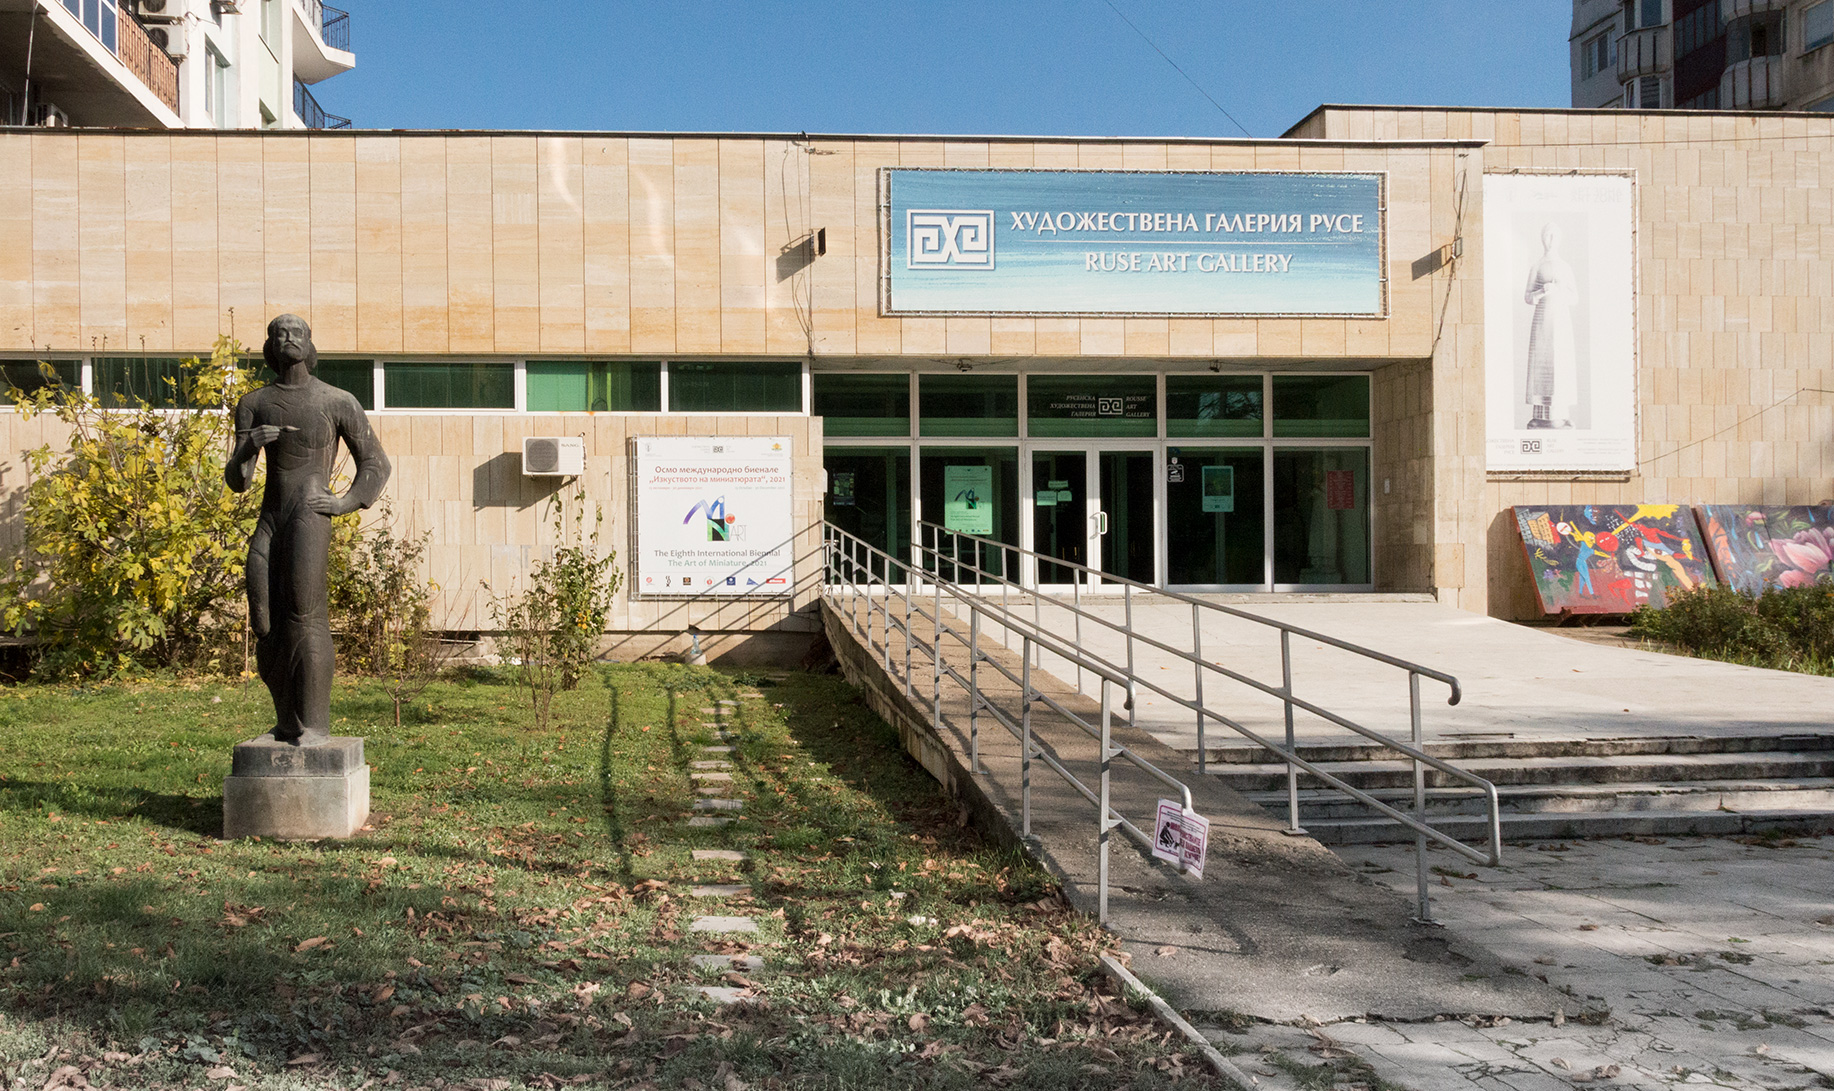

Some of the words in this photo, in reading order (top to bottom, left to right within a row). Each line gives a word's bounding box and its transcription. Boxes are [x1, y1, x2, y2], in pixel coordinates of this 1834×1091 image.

[1010, 211, 1199, 236] ХУДОЖЕСТВЕНА
[1205, 213, 1302, 233] ГАЛЕРИЯ
[1310, 214, 1364, 233] РУСЕ
[1085, 253, 1141, 272] RUSE
[1148, 253, 1190, 272] ART
[1197, 253, 1293, 273] GALLERY
[655, 466, 678, 474] Осмо
[679, 466, 742, 475] международно
[744, 466, 779, 474] биенале
[654, 549, 670, 557] The
[671, 549, 696, 559] Eighth
[697, 549, 748, 557] International
[749, 549, 780, 557] Biennial
[668, 559, 683, 567] The
[684, 559, 697, 567] Art
[698, 559, 707, 567] of
